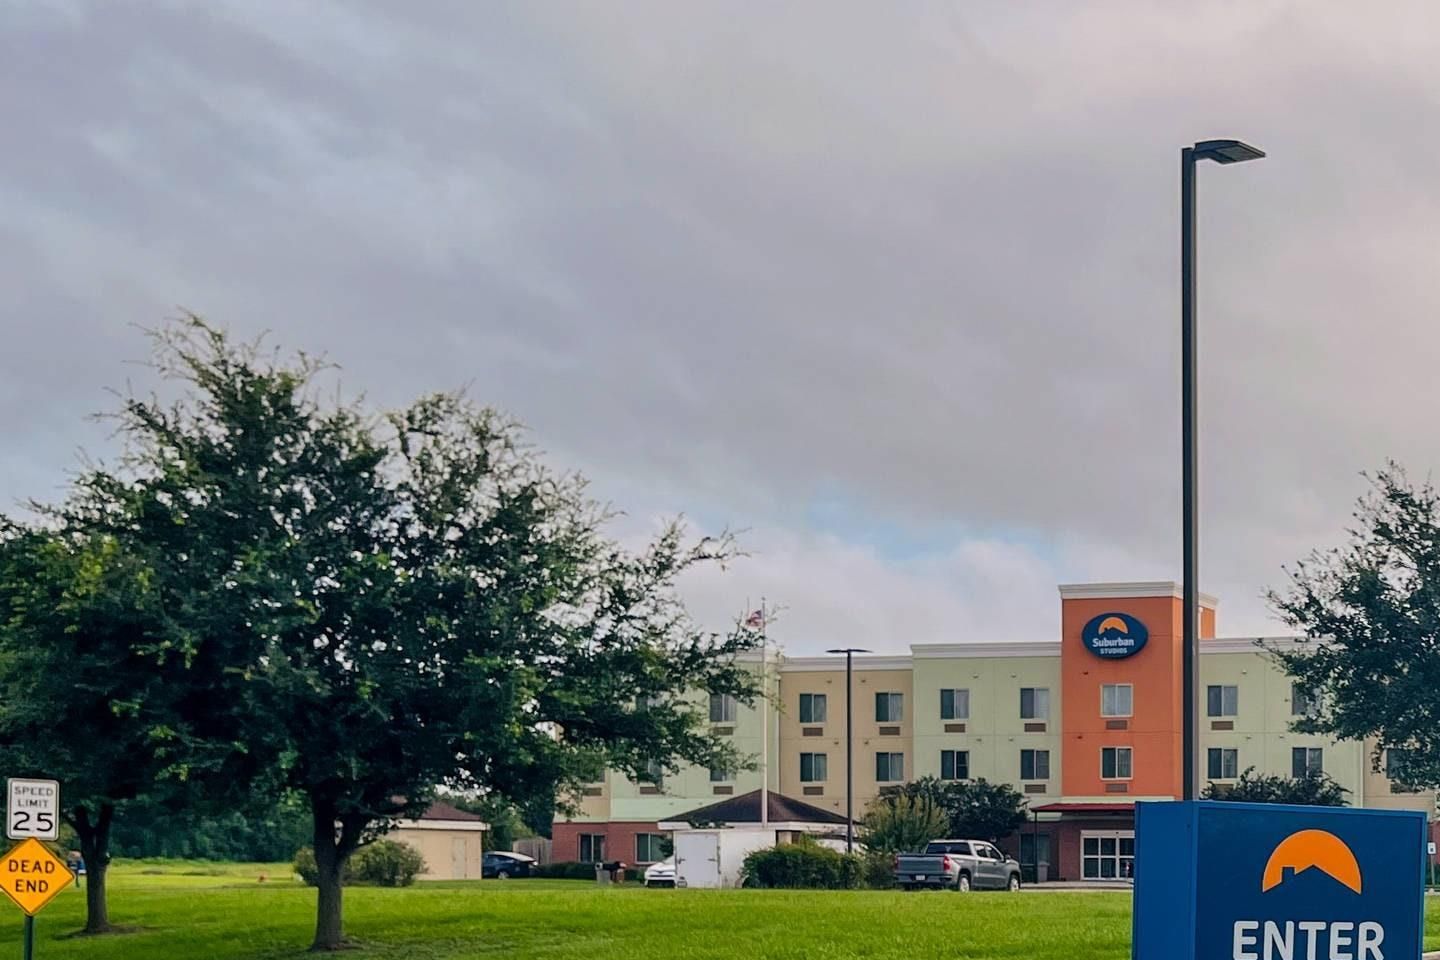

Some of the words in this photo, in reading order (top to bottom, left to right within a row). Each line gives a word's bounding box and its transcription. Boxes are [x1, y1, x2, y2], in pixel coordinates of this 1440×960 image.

[1092, 637, 1134, 647] Suburban
[14, 786, 54, 796] SPEED
[18, 799, 48, 808] LIMIT
[13, 811, 53, 832] 25
[8, 859, 55, 873] DEAD
[15, 879, 49, 893] END
